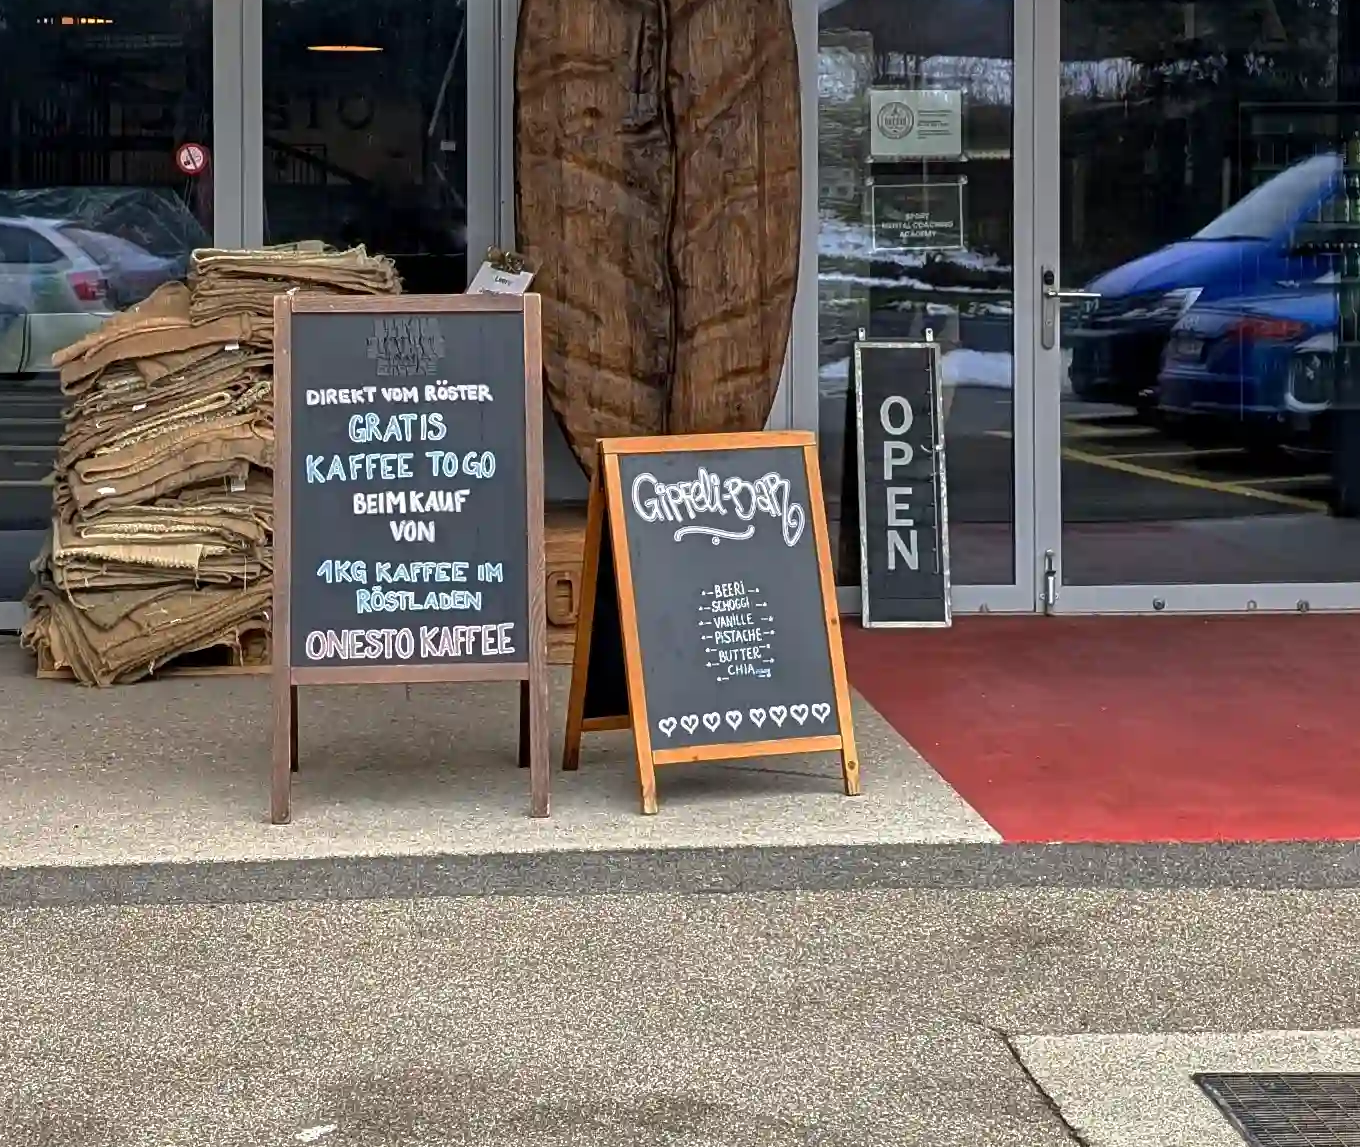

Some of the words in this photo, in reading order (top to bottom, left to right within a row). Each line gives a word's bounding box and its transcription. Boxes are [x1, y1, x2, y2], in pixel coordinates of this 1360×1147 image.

[306, 386, 377, 406] DIREKT
[380, 386, 419, 404] VOM
[424, 379, 494, 402] RÖSTER
[348, 412, 447, 444] GRATIS
[305, 452, 415, 484] KAFFEE
[424, 450, 459, 478] TO
[461, 450, 497, 479] GO
[878, 394, 920, 571] OPEN
[409, 488, 471, 513] KAUF
[389, 519, 436, 543] VON
[316, 559, 368, 585] 1KG
[375, 561, 470, 583] KAFFEE
[477, 561, 504, 583] IM
[355, 586, 482, 614] RÖSTLADEN
[305, 627, 415, 661] ONESTO
[419, 622, 516, 656] KAFFEE
[718, 646, 762, 664] BUTTER
[727, 663, 756, 676] CHIA
